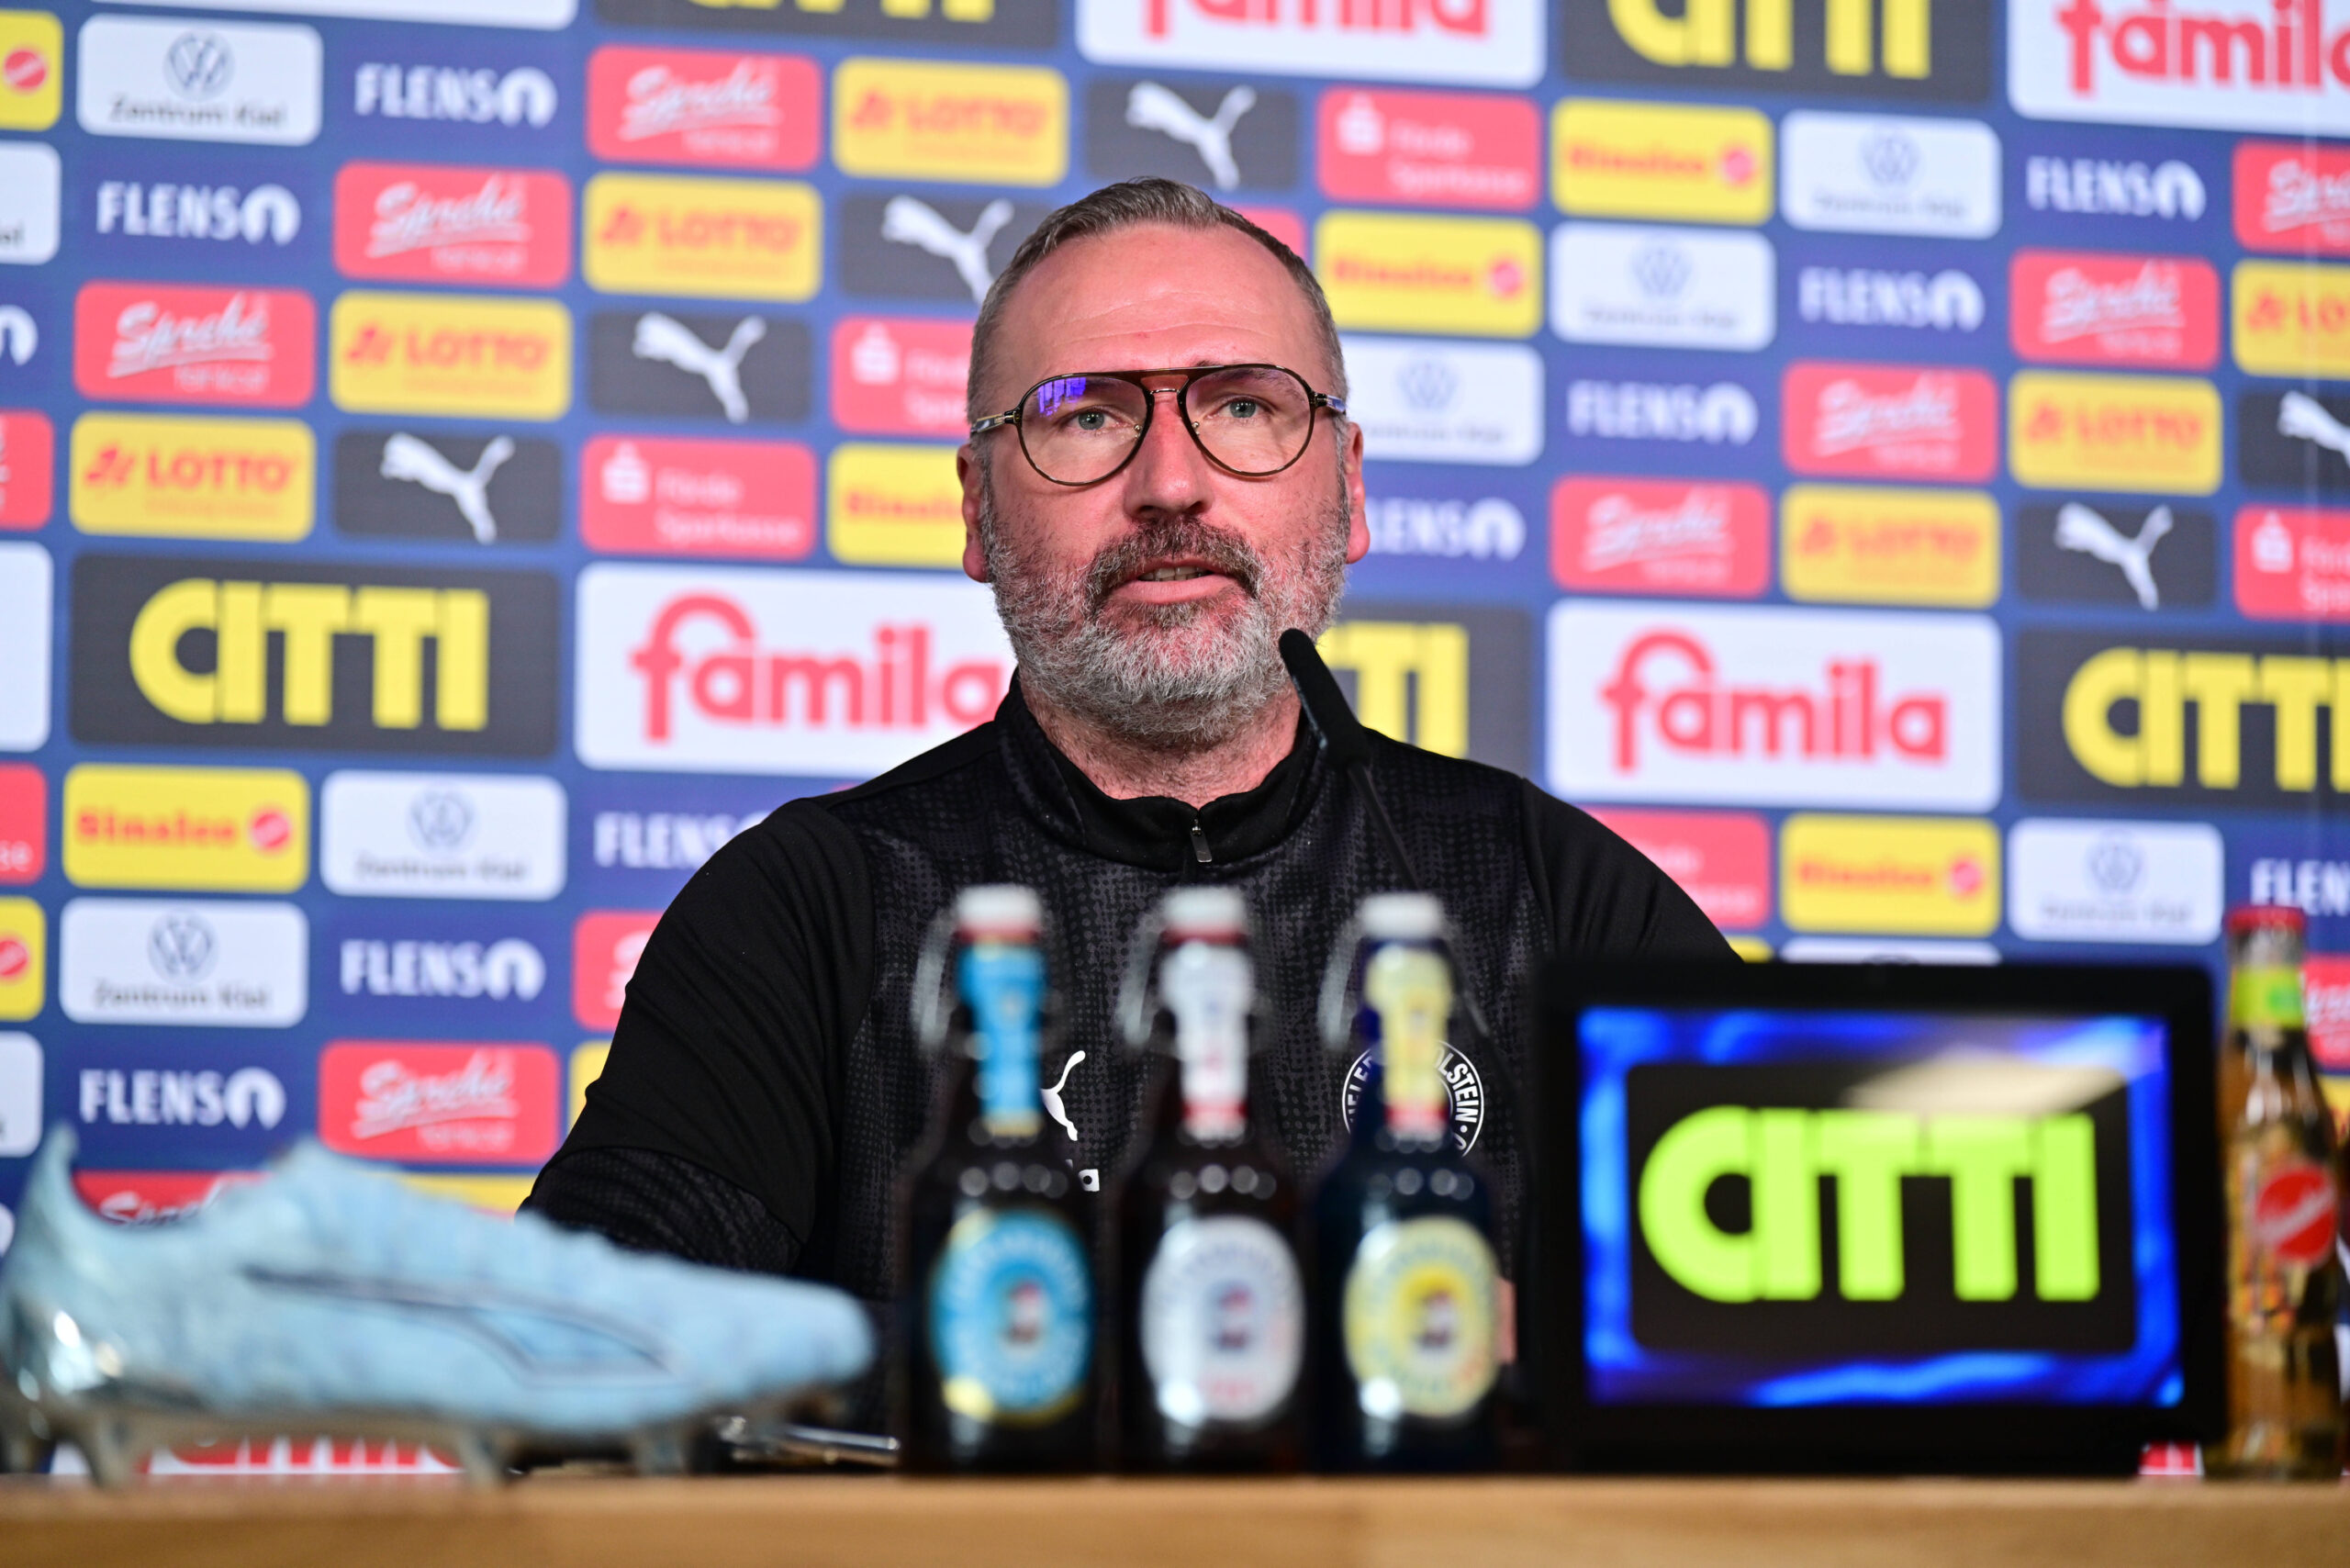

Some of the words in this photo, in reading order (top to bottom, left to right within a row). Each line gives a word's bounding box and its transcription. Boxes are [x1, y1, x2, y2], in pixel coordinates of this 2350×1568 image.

[2056, 0, 2350, 95] famil
[906, 95, 1048, 135] LOTTO
[658, 210, 800, 252] LOTTO
[406, 328, 550, 373] LOTTO
[146, 449, 293, 494] LOTTO
[1366, 497, 1468, 557] LENS
[129, 578, 489, 731] CITTI
[630, 588, 1008, 745] famila
[1599, 628, 1951, 777] famila
[2251, 858, 2350, 916] FLEN
[1639, 1104, 2100, 1304] CITTI
